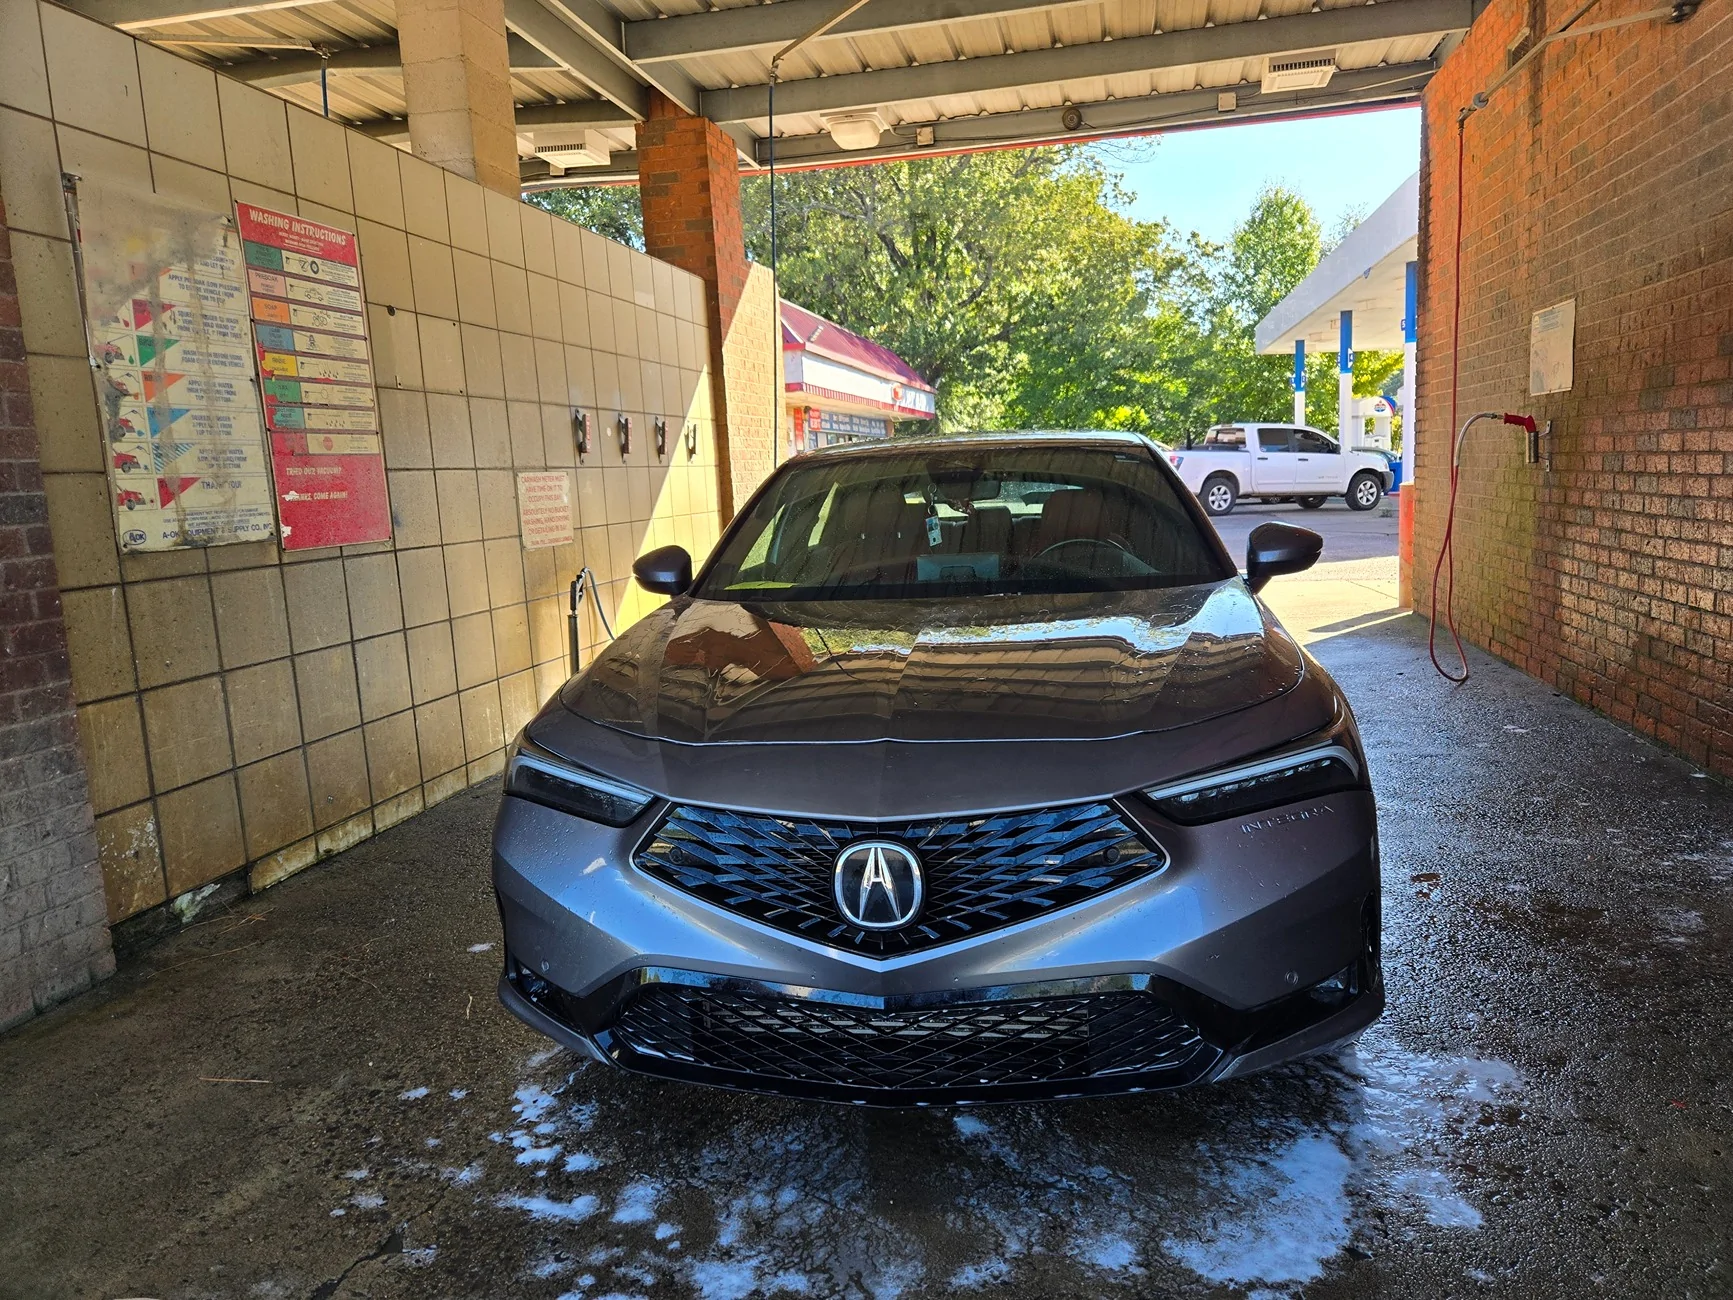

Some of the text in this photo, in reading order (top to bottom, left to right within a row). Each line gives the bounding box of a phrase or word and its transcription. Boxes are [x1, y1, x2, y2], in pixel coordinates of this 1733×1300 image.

[249, 208, 346, 246] WASHING INSTRUCTIONS
[184, 276, 205, 286] PREOAK
[254, 272, 278, 282] PRESOAK
[203, 287, 221, 296] VEHICLE
[286, 467, 303, 476] TRIED
[314, 492, 329, 500] COME
[330, 491, 348, 499] AGAIN!
[162, 530, 179, 539] A-OK
[184, 526, 219, 537] QUIPMENT
